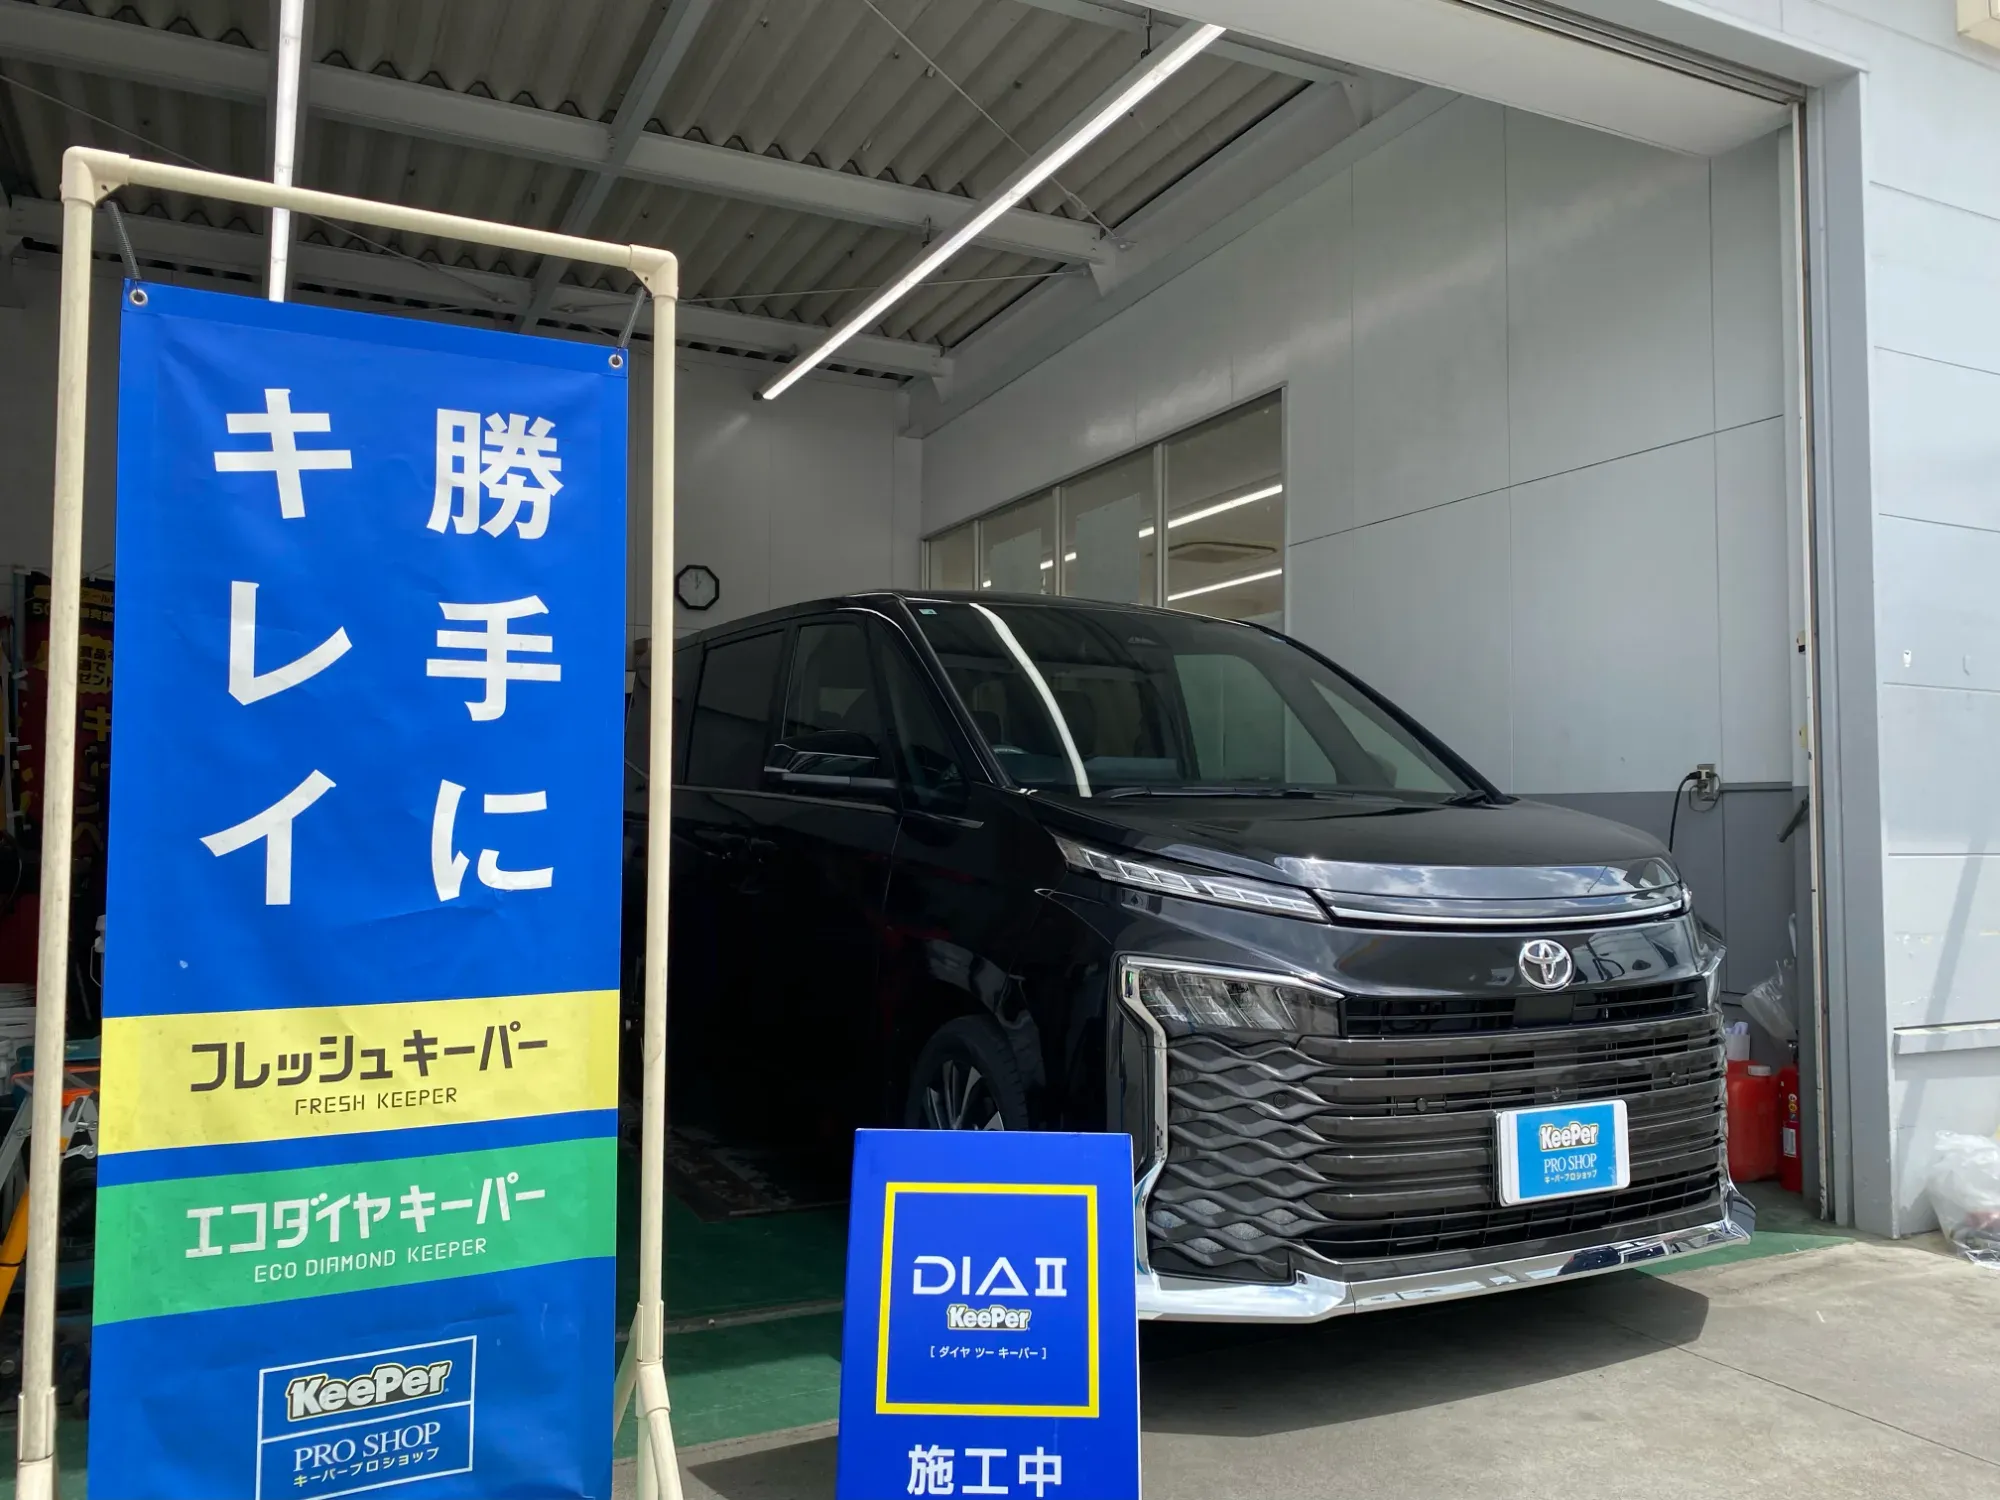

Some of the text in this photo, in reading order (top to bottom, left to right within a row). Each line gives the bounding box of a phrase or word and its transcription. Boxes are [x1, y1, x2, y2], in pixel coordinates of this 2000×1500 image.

[200, 388, 353, 906] キレイ
[426, 408, 564, 902] 勝手に
[190, 1020, 548, 1092] フレッシュキーパー
[295, 1087, 457, 1116] FRESH KEEPER
[1540, 1121, 1600, 1152] KeePer
[1544, 1153, 1597, 1174] PRO SHOP
[185, 1171, 546, 1259] エコダイヤキーパー
[254, 1238, 487, 1283] ECO DIAMOND KEEPER
[947, 1304, 1032, 1330] KeePer
[286, 1360, 452, 1422] KeePer
[293, 1421, 441, 1472] PRO SHOP
[293, 1447, 440, 1487] キーパープロショップ
[907, 1444, 1062, 1498] 施工中
